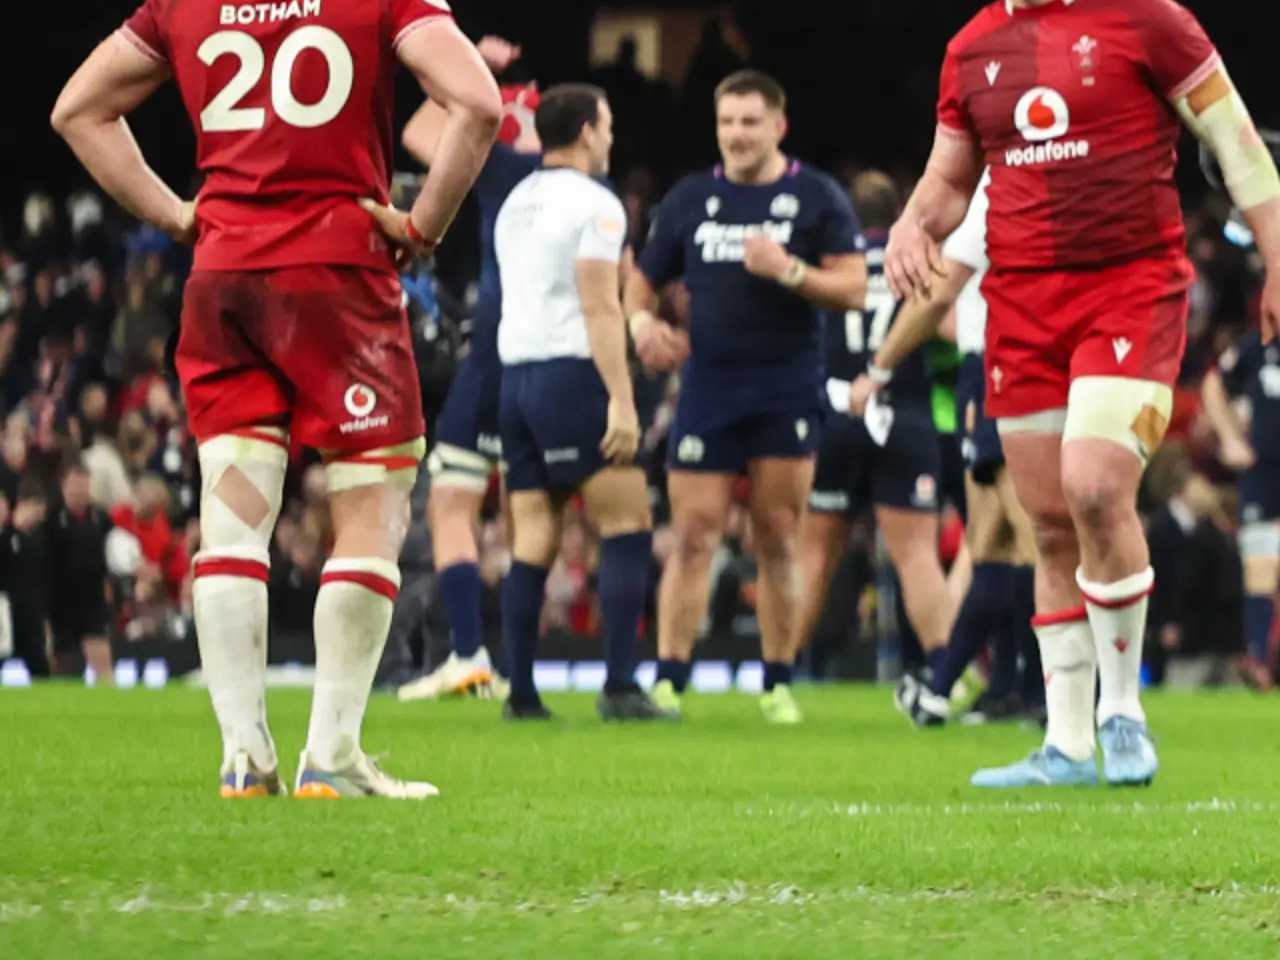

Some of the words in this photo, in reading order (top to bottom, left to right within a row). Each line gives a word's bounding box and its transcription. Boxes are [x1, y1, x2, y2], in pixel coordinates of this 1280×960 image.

[196, 24, 354, 132] 20
[1004, 139, 1090, 167] vodafone
[339, 414, 390, 435] vodafone
